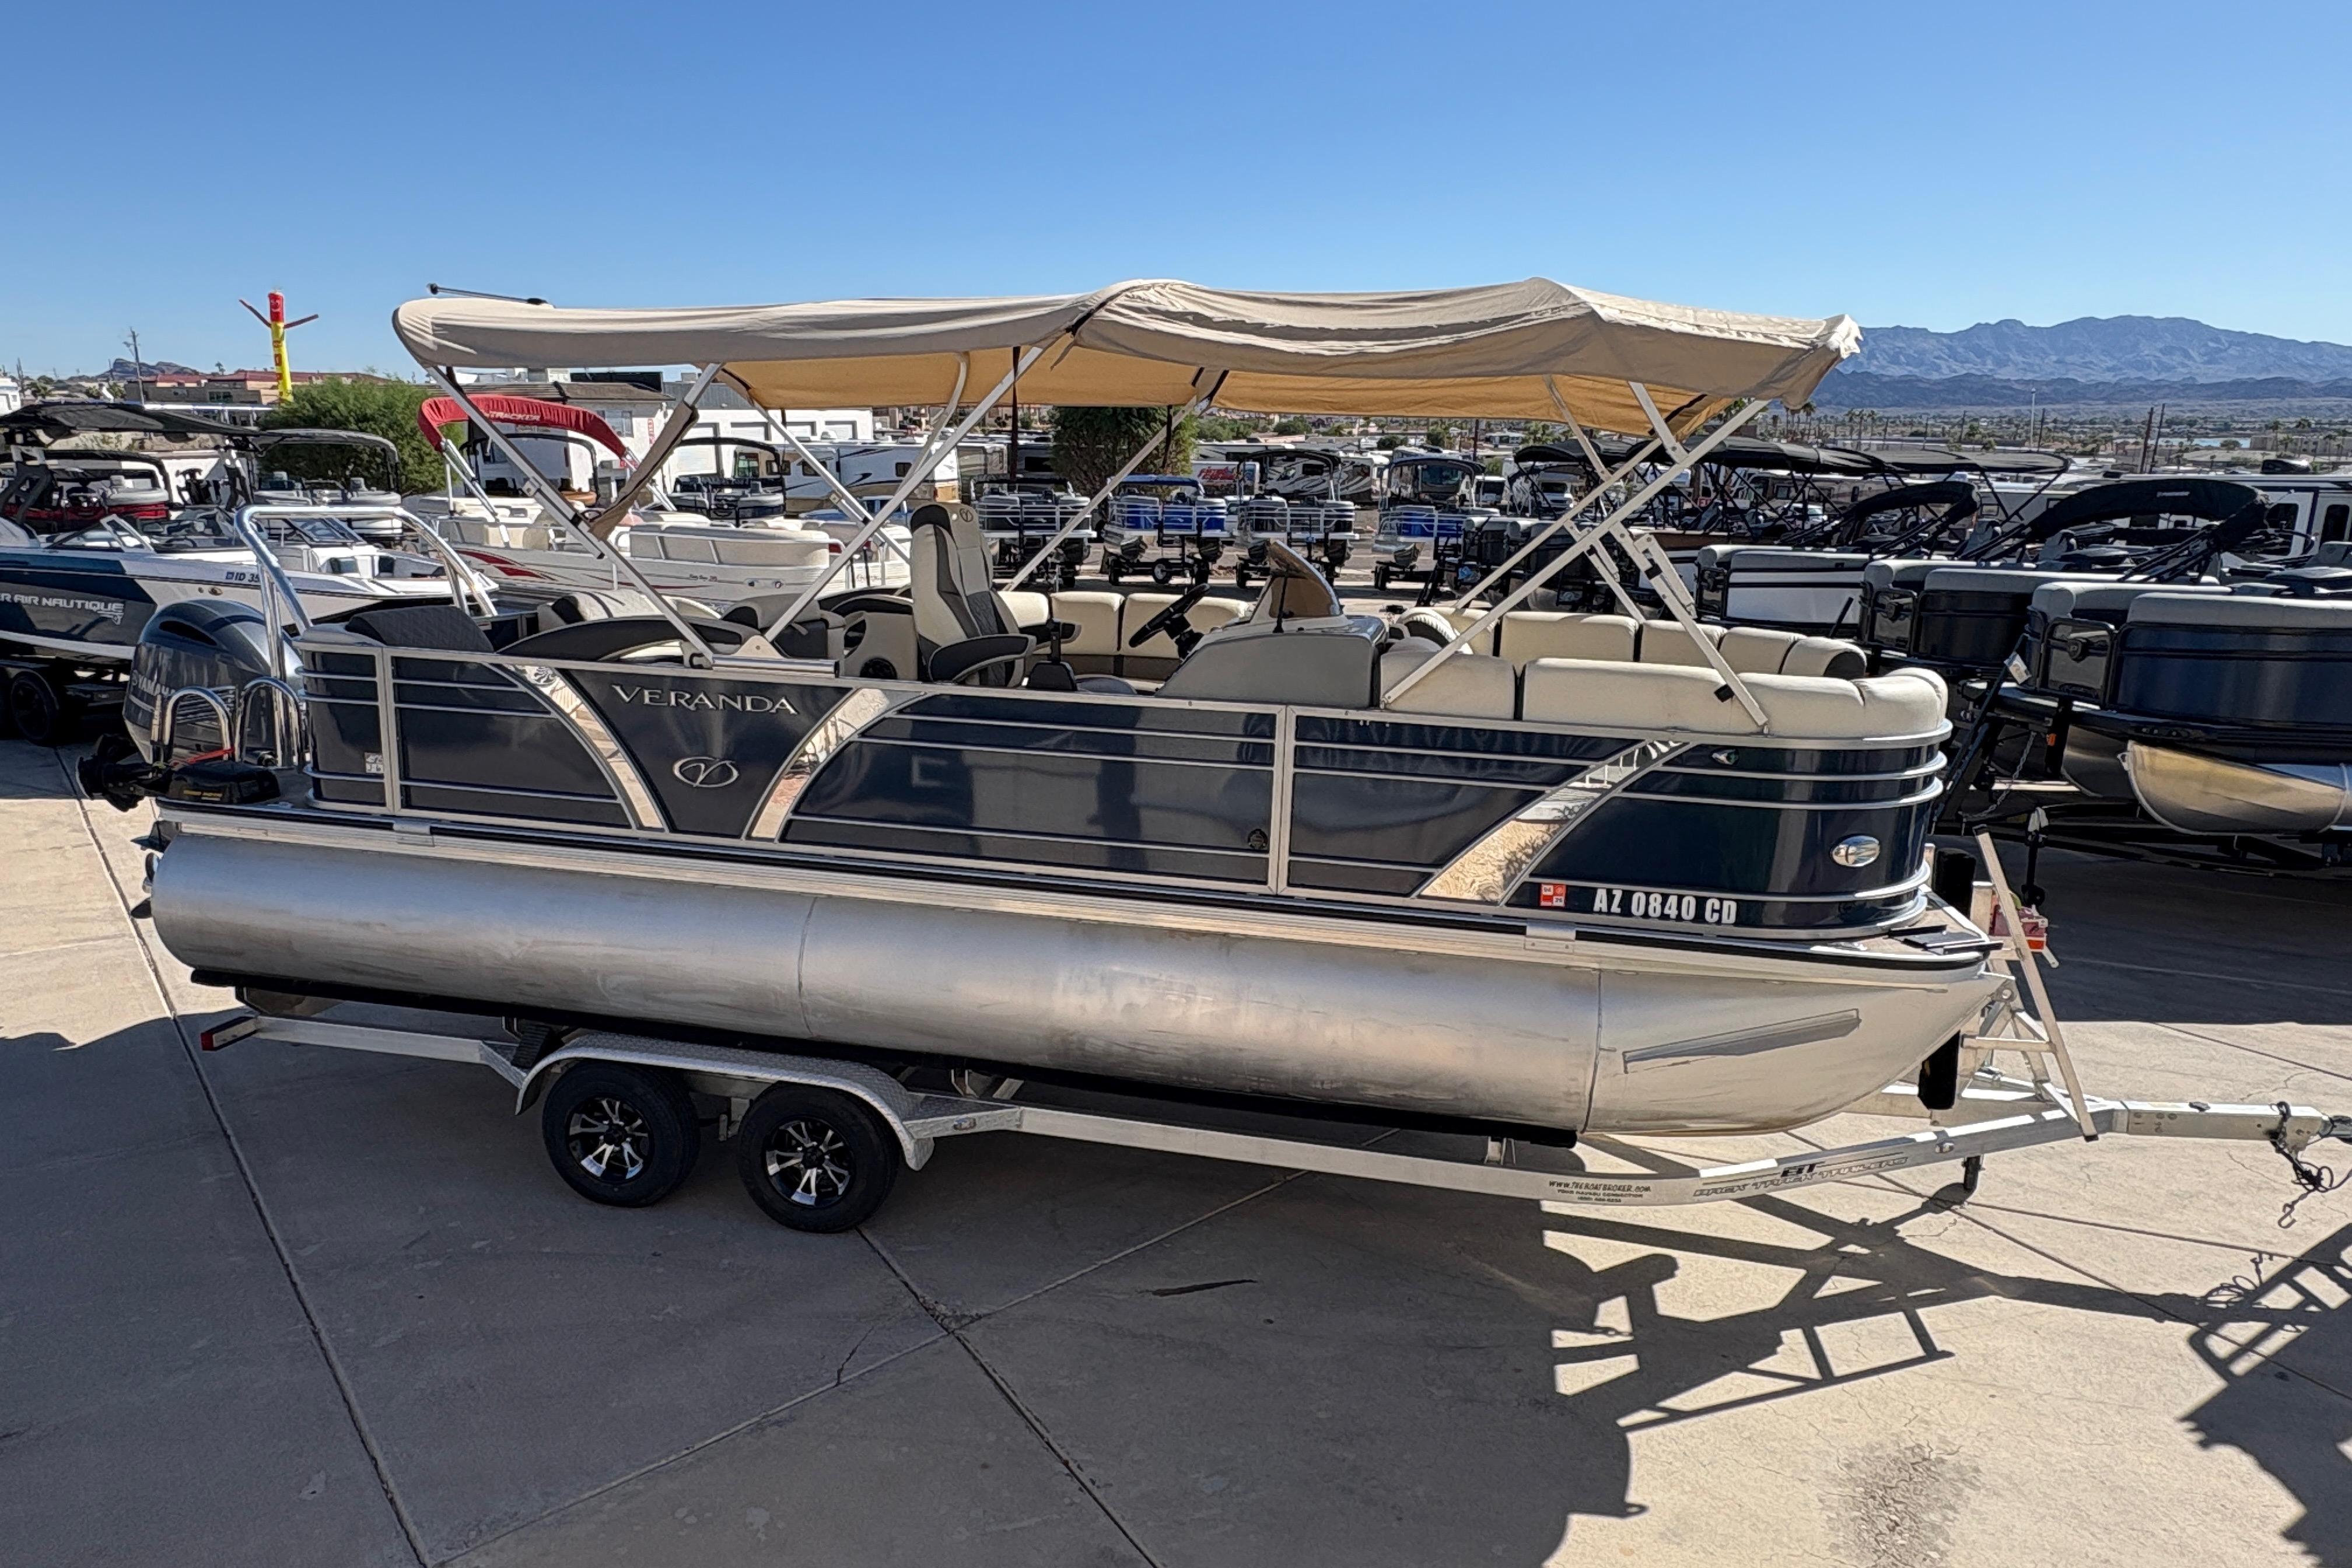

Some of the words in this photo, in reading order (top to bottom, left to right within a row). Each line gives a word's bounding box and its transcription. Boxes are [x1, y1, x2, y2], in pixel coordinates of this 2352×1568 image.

[235, 572, 246, 581] ID
[13, 593, 39, 606] AIR
[41, 597, 124, 612] NAUTIQUE
[612, 684, 798, 715] VERANDA
[1593, 888, 1623, 914] AZ
[1631, 891, 1696, 921] 0840
[1704, 898, 1737, 924] CD
